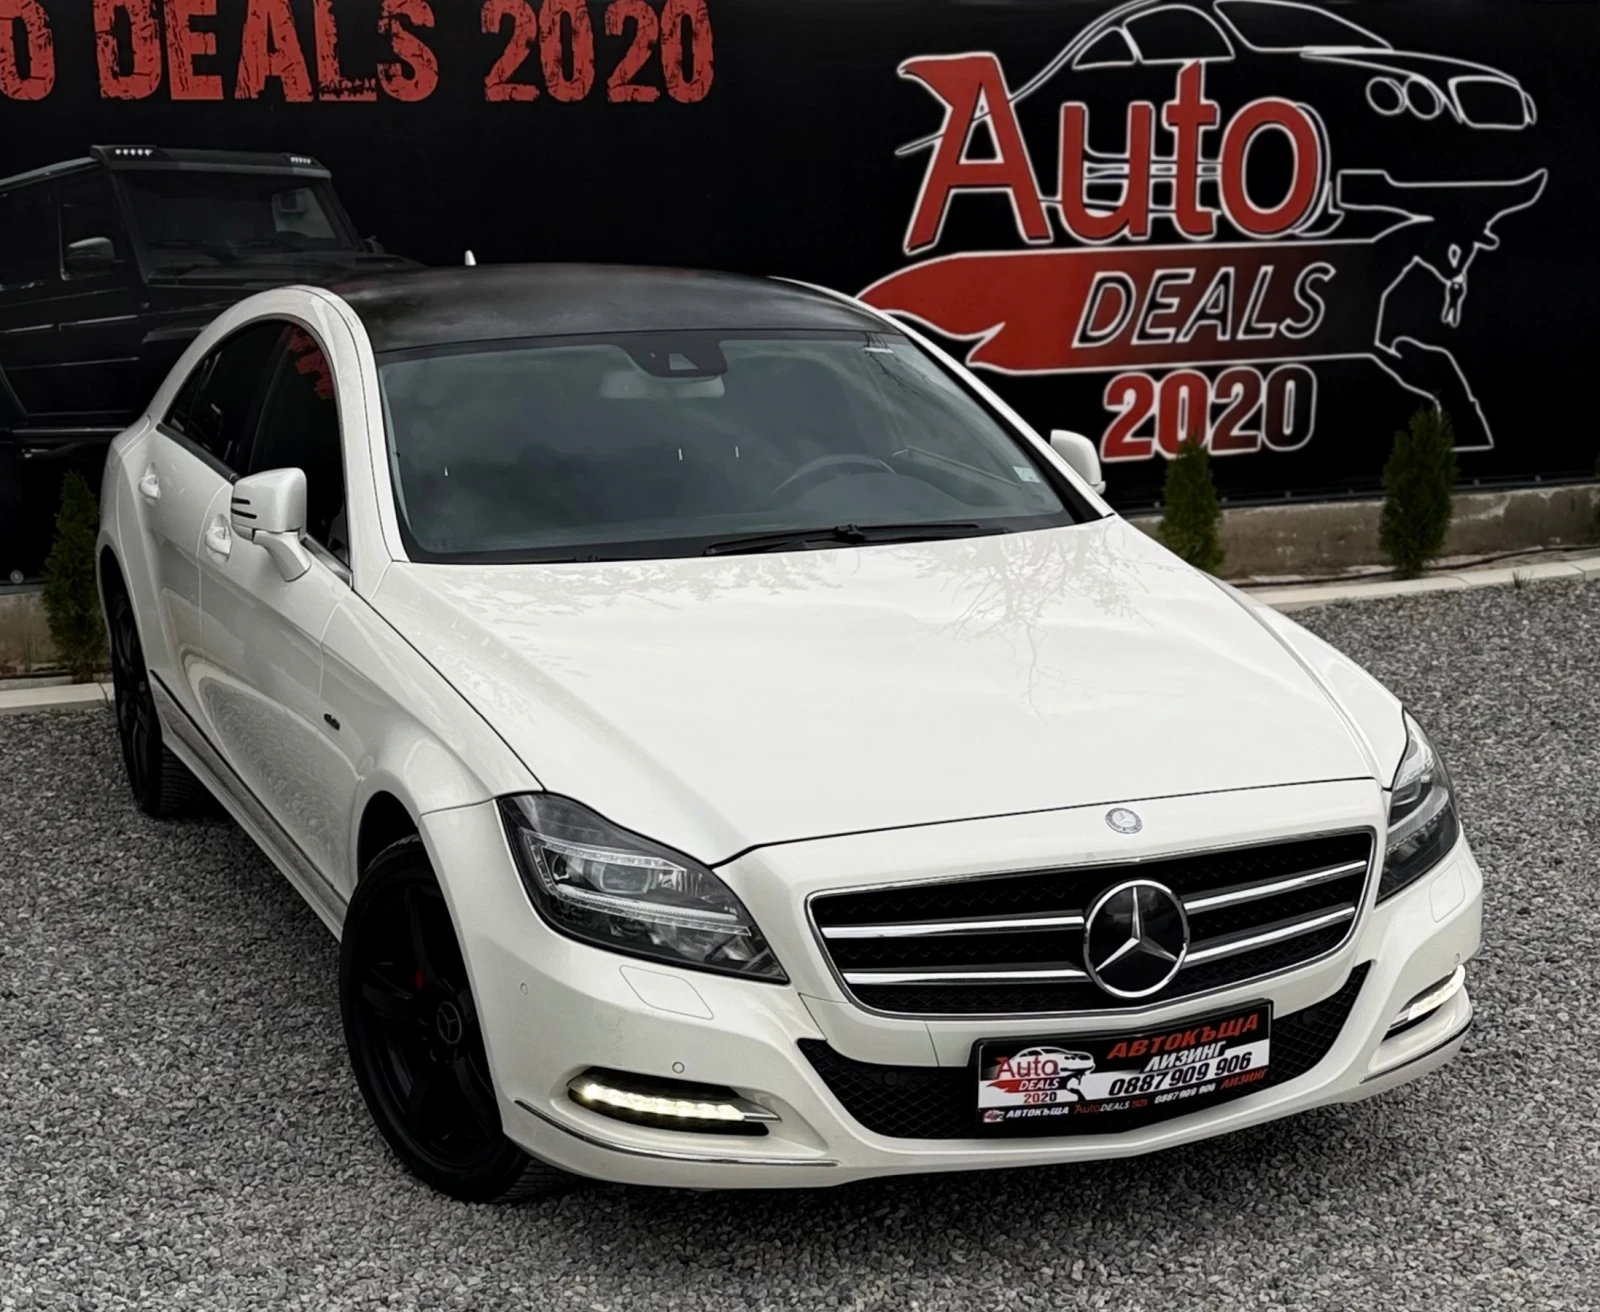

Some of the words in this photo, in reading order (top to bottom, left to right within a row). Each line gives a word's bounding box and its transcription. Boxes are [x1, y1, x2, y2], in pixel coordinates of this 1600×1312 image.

[94, 0, 438, 102] DEALS
[481, 0, 715, 102] 2020
[897, 51, 1322, 255] Auto
[1071, 262, 1337, 349] DEALS
[1100, 362, 1317, 463] 2020
[1106, 1013, 1259, 1059] АВТОКЪЩА
[1143, 1040, 1226, 1073] ЛИЗИНГ
[995, 1056, 1060, 1080] Auto
[1018, 1078, 1060, 1091] DEALS
[1108, 1073, 1170, 1097] 0887
[1168, 1062, 1211, 1087] 909
[1214, 1051, 1253, 1077] 906
[1023, 1091, 1057, 1104] 2020
